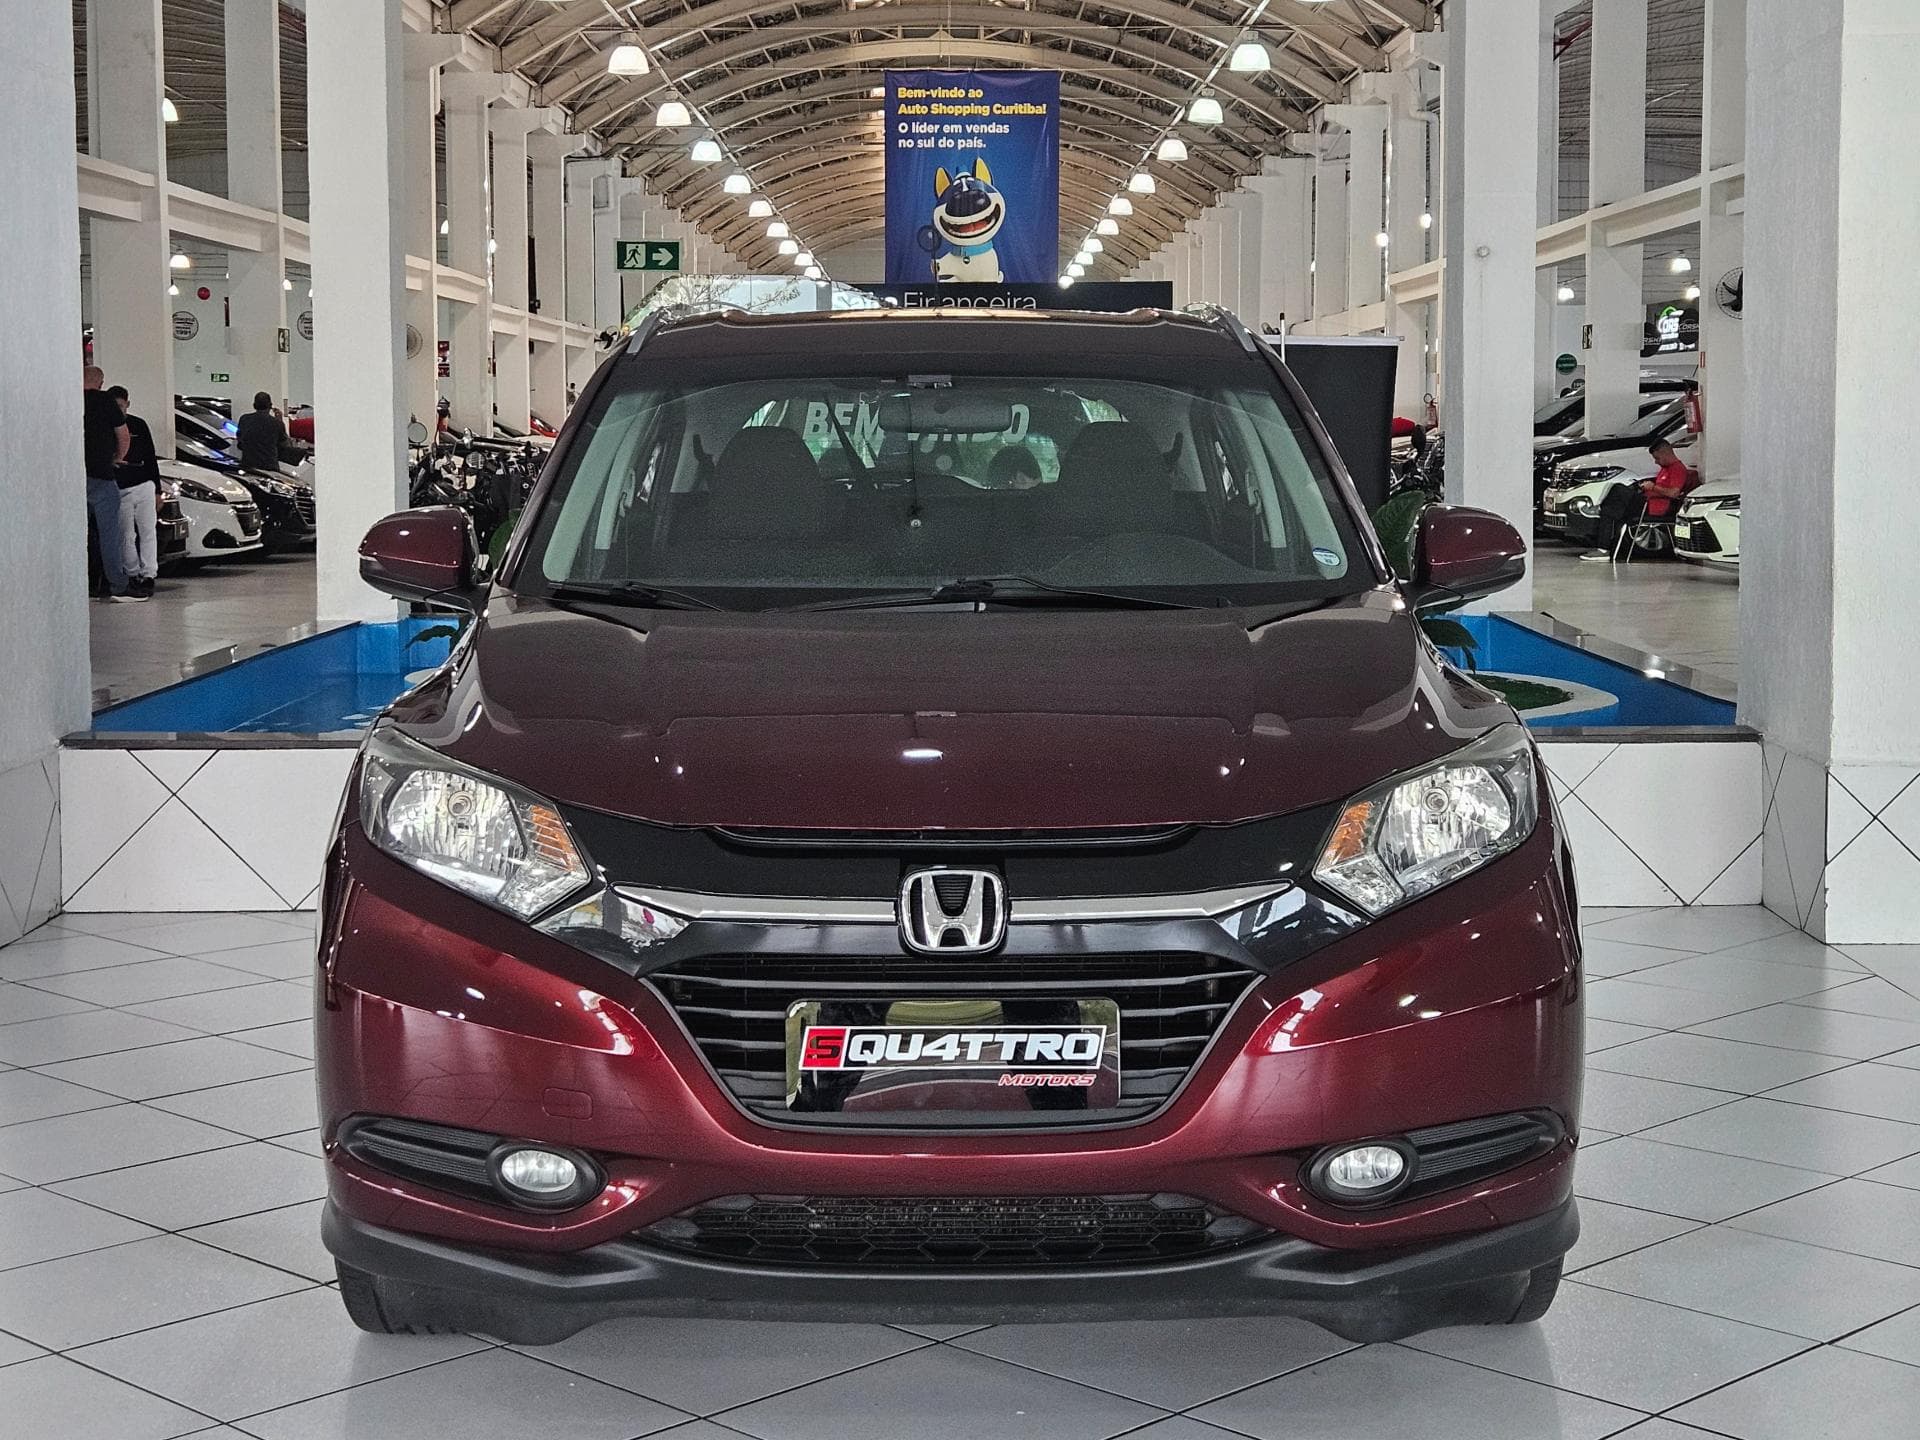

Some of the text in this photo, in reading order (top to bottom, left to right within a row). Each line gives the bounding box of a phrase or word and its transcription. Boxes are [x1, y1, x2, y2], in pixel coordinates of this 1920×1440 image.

[898, 87, 983, 98] Bem-vindo ao
[898, 103, 1047, 116] Auto Shopping Curitiba!
[898, 122, 1009, 133] O líder em vendas
[898, 136, 986, 150] no sul do país.
[802, 402, 885, 441] BEM
[998, 1073, 1097, 1087] MOTORS
